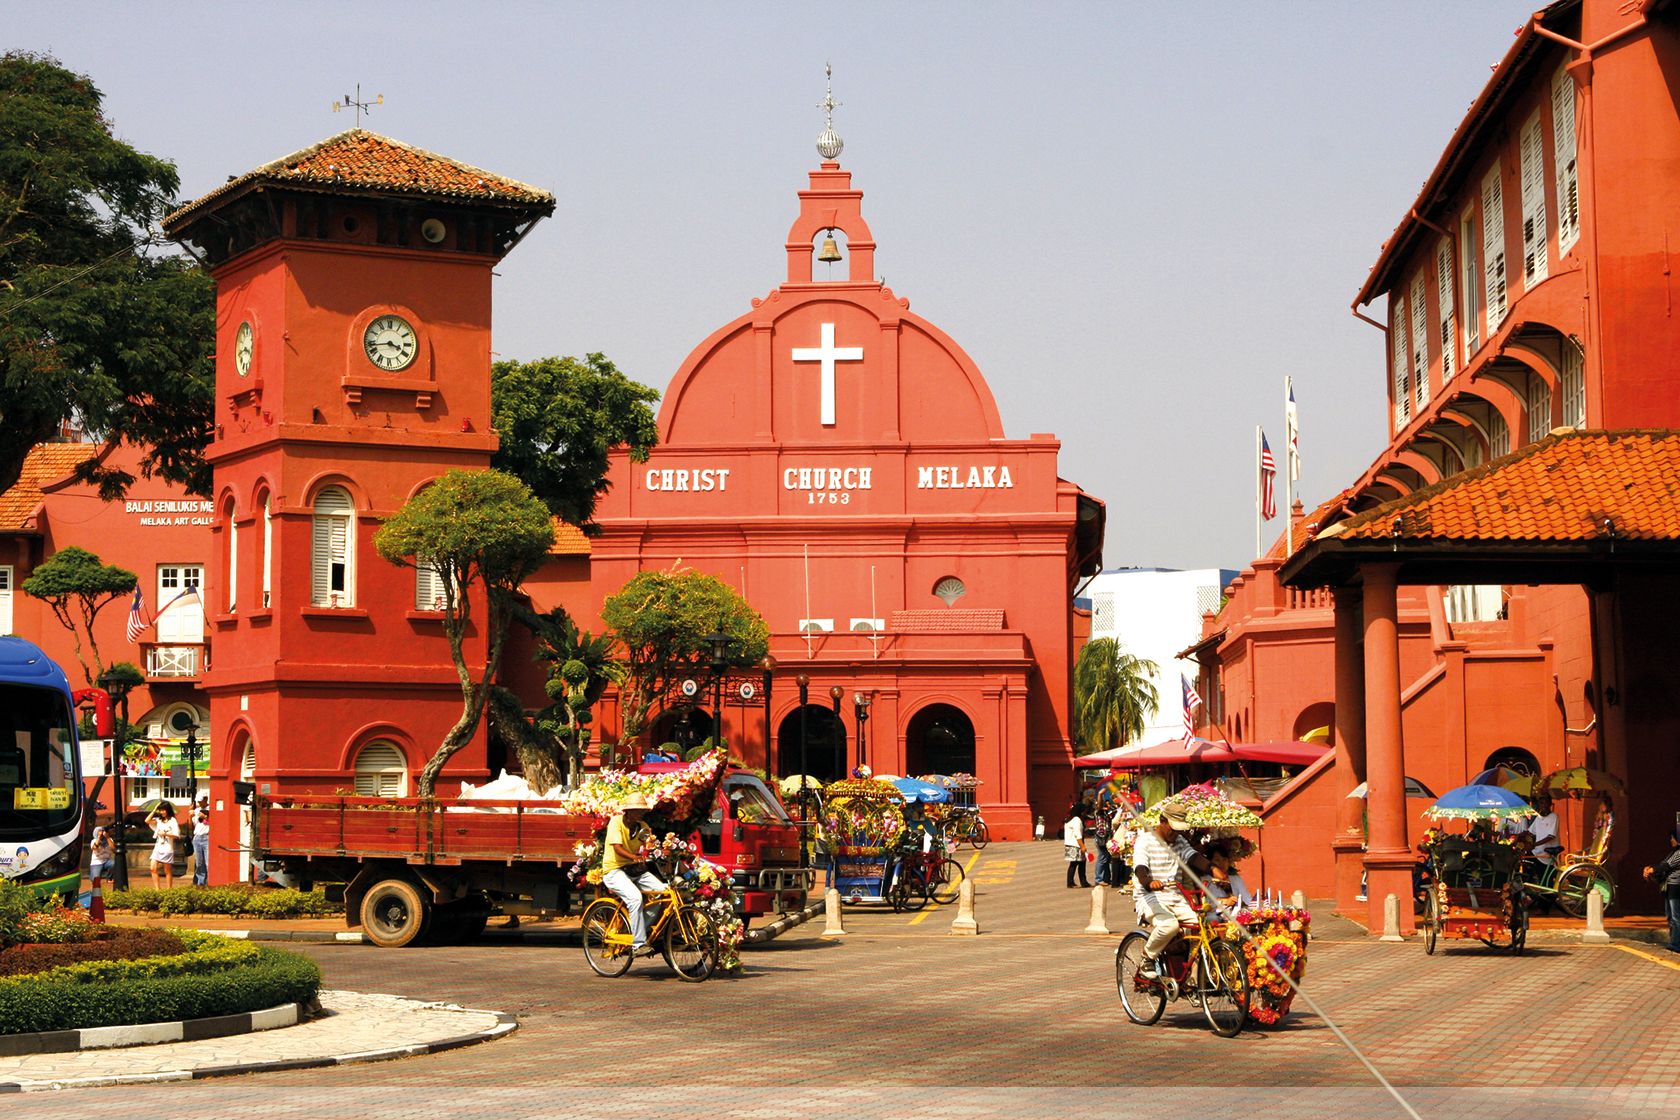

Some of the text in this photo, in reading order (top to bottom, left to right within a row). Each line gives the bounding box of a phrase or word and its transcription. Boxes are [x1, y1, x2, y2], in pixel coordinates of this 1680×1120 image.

[646, 466, 1014, 491] CHRIST CHURCH MELAKA
[808, 492, 850, 505] 1753
[125, 501, 152, 513] BALAI
[140, 517, 172, 526] MELAKA
[174, 517, 189, 525] ART
